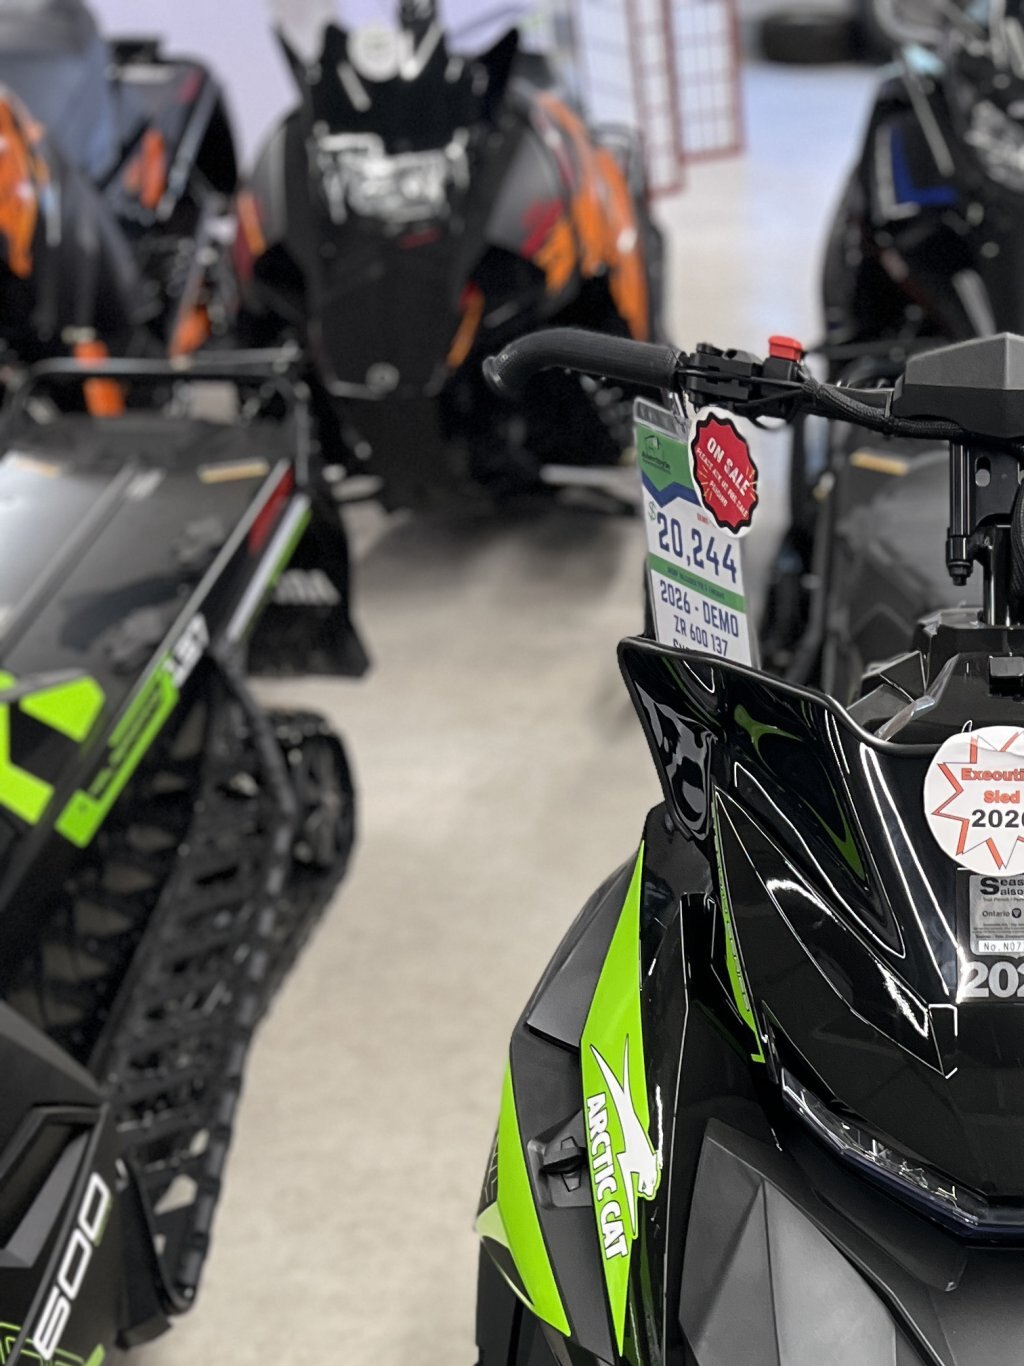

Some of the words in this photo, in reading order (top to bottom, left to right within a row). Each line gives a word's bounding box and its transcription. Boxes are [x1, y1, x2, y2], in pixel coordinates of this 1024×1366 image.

[706, 437, 725, 463] ON
[723, 458, 751, 496] SALE
[657, 511, 737, 584] 20,244
[660, 580, 691, 615] 2026
[703, 601, 739, 637] DEMO
[674, 615, 687, 637] ZR
[690, 624, 708, 648] 600
[711, 634, 728, 656] 137
[983, 790, 1020, 804] Sled
[982, 910, 1010, 918] Ontario
[586, 1091, 618, 1202] ARCTIC
[600, 1200, 629, 1260] CAT
[32, 1172, 112, 1361] 600
